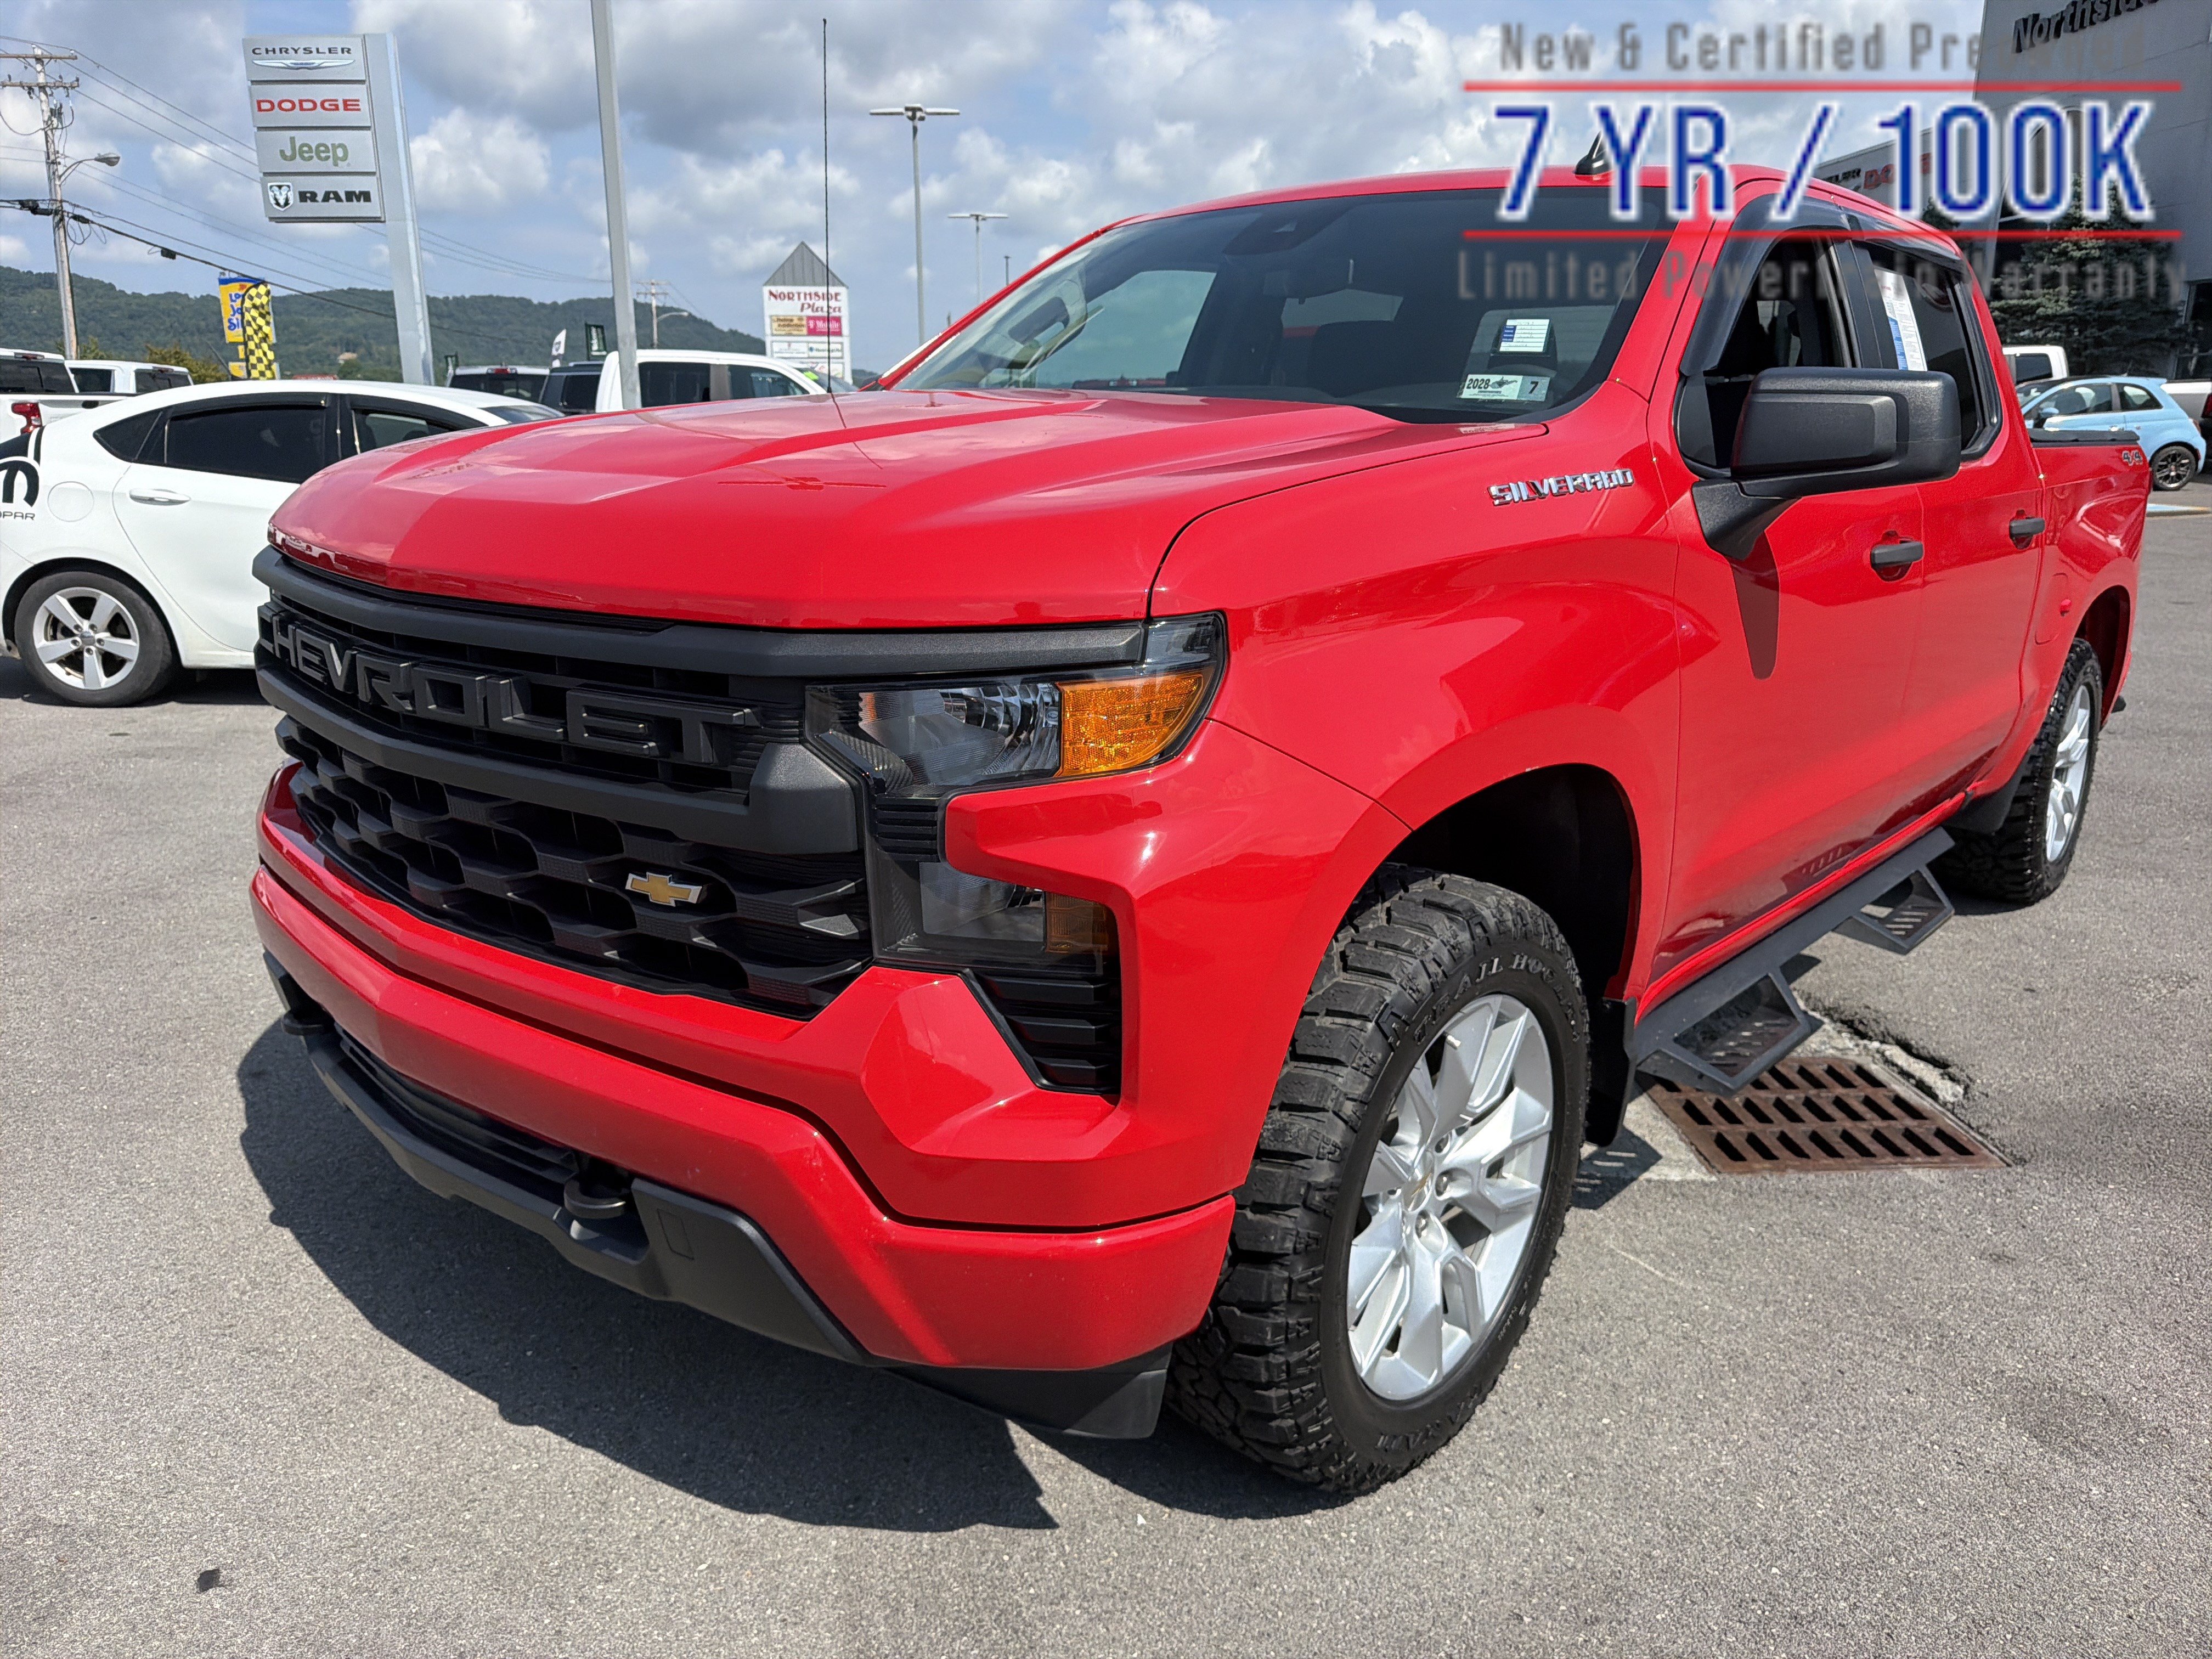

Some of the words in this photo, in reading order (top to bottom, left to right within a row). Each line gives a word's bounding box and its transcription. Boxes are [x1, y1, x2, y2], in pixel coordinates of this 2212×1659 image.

[2012, 0, 2159, 53] Northsi
[252, 47, 352, 55] CHRYSLER
[256, 99, 361, 112] DODGE
[279, 136, 349, 167] Jeep
[298, 190, 371, 202] RAM
[768, 289, 842, 302] NORTHSIDE
[1466, 378, 1491, 390] 2028
[1528, 381, 1538, 394] 7
[1487, 468, 1634, 506] SILVERADO
[0, 511, 35, 520] PAR
[257, 602, 760, 765] CHEVROLET
